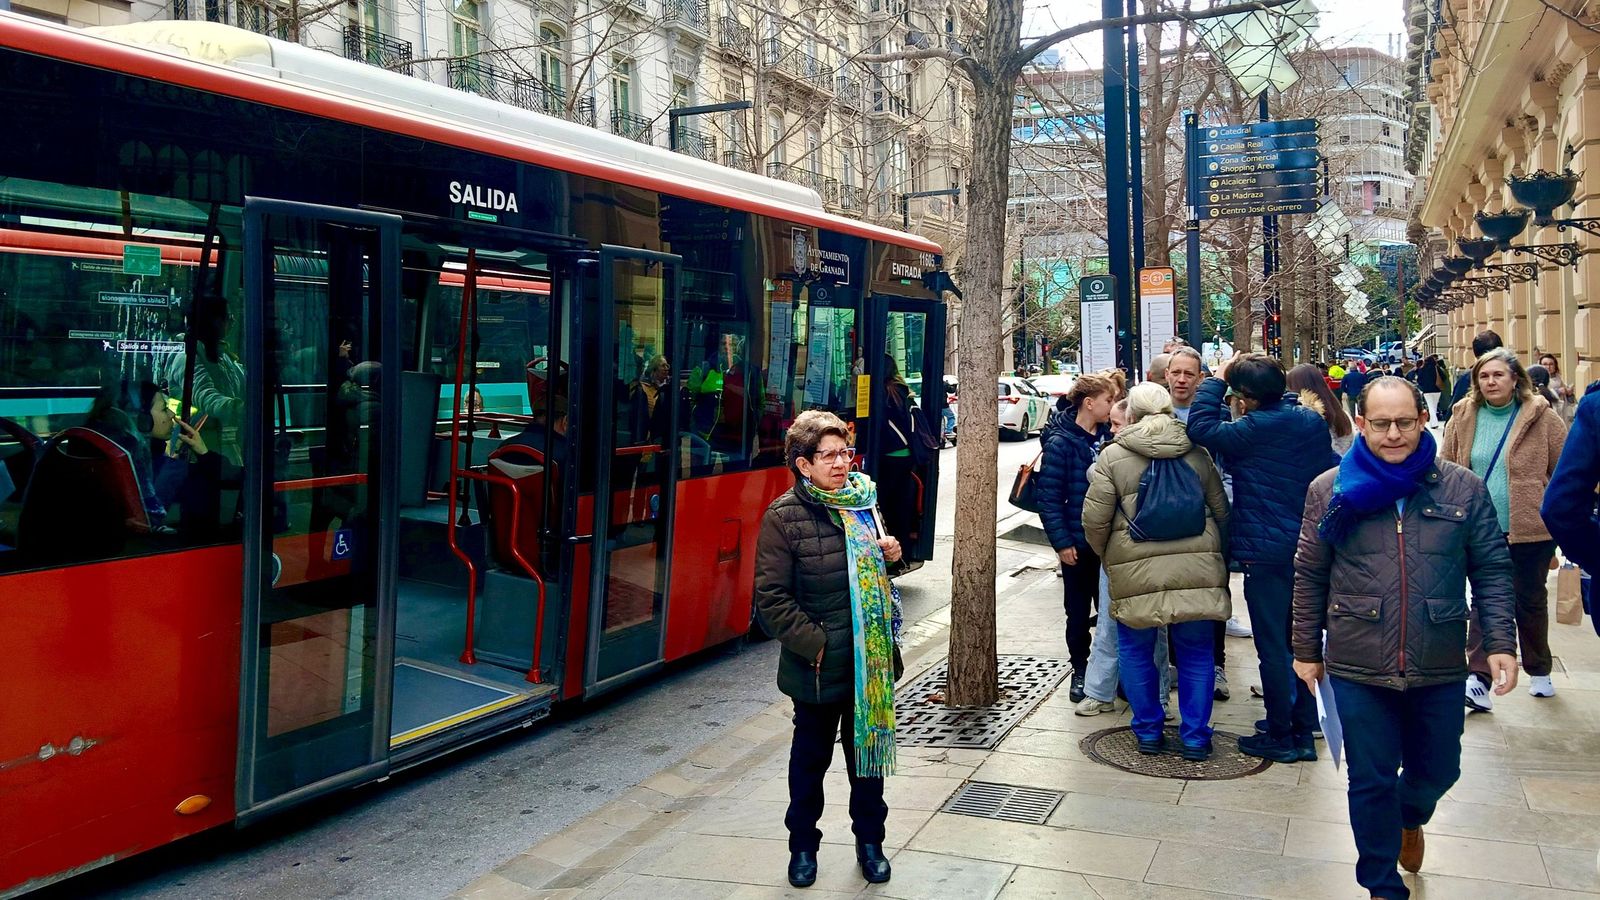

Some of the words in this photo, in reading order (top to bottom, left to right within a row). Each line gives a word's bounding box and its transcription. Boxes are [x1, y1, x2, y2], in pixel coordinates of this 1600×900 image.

[1220, 127, 1251, 136] Catedral
[1220, 143, 1245, 152] Capilla
[1247, 141, 1264, 149] Real
[1241, 153, 1279, 163] Comercial
[1220, 165, 1255, 173] Shopping
[1257, 162, 1275, 170] Area
[449, 181, 519, 213] SALIDA
[892, 262, 922, 280] ENTRADA
[120, 342, 139, 350] Salida
